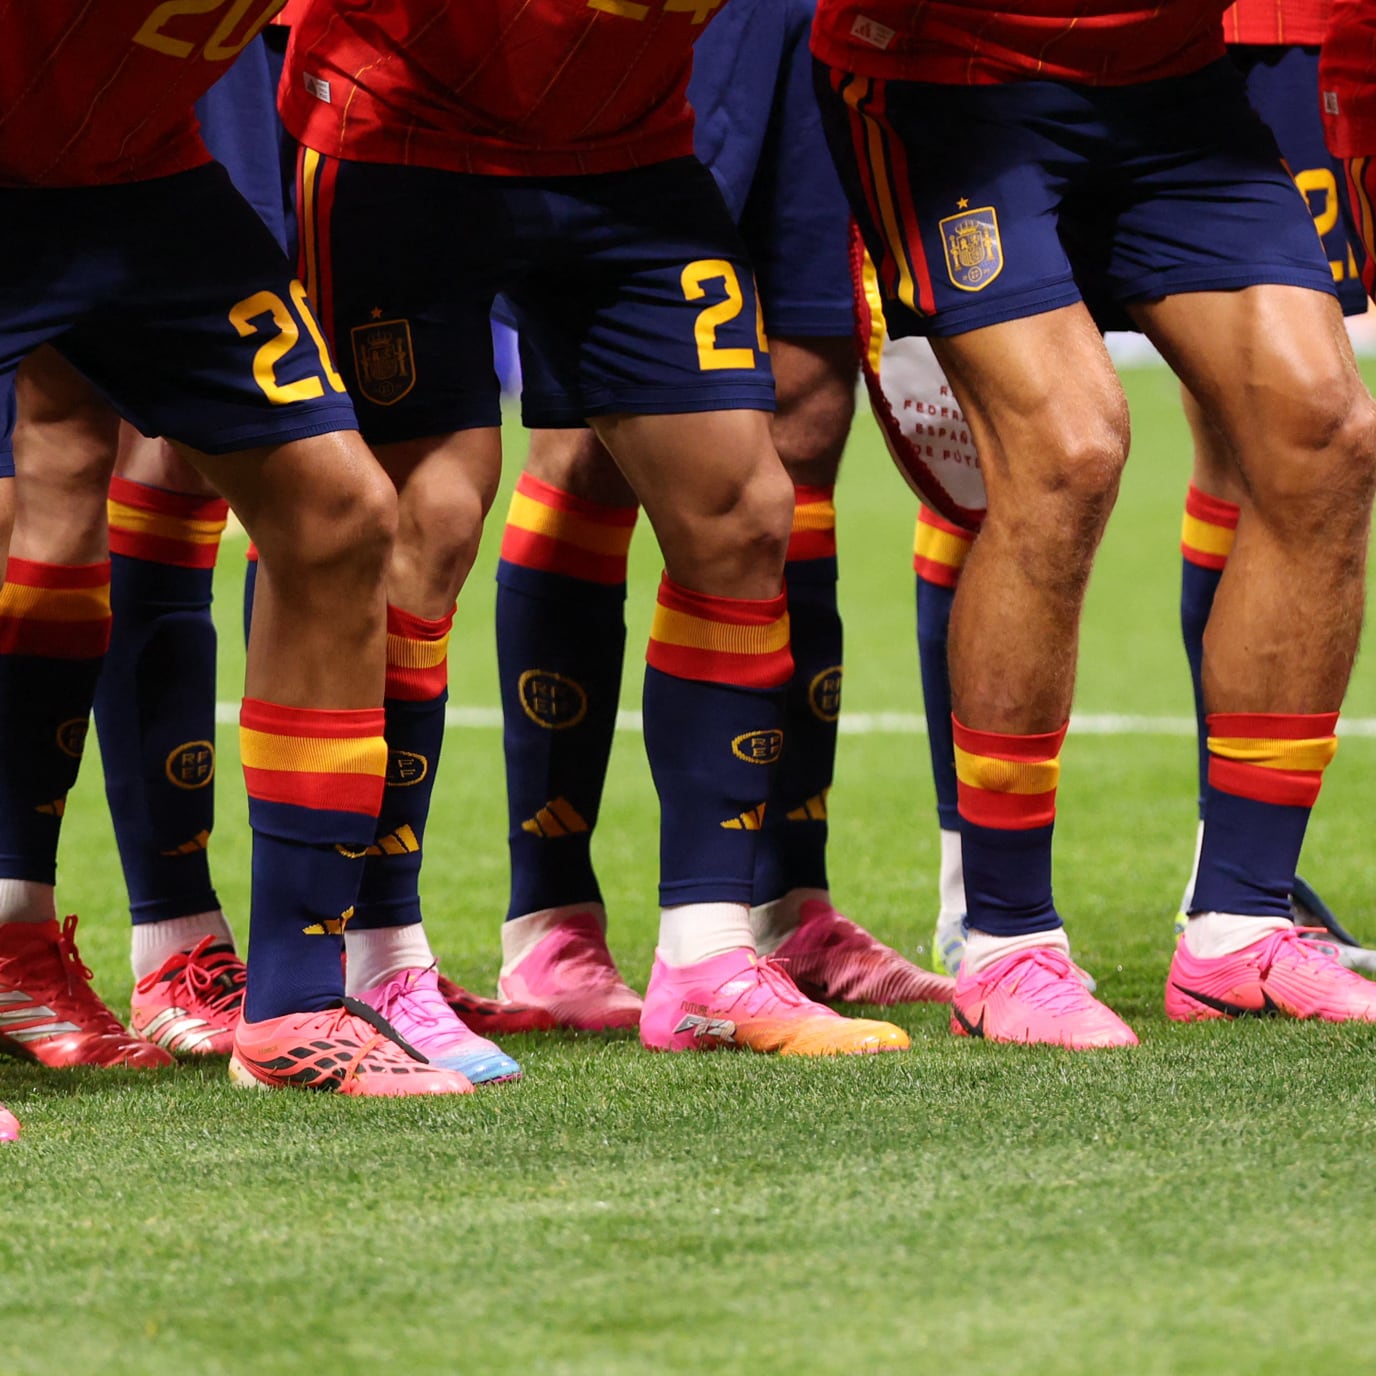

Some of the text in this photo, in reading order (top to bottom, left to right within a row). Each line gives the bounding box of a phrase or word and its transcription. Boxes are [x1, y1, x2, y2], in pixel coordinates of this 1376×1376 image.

[681, 259, 769, 371] 2
[904, 399, 966, 422] FEDER
[181, 750, 209, 766] RF
[181, 764, 208, 780] EF
